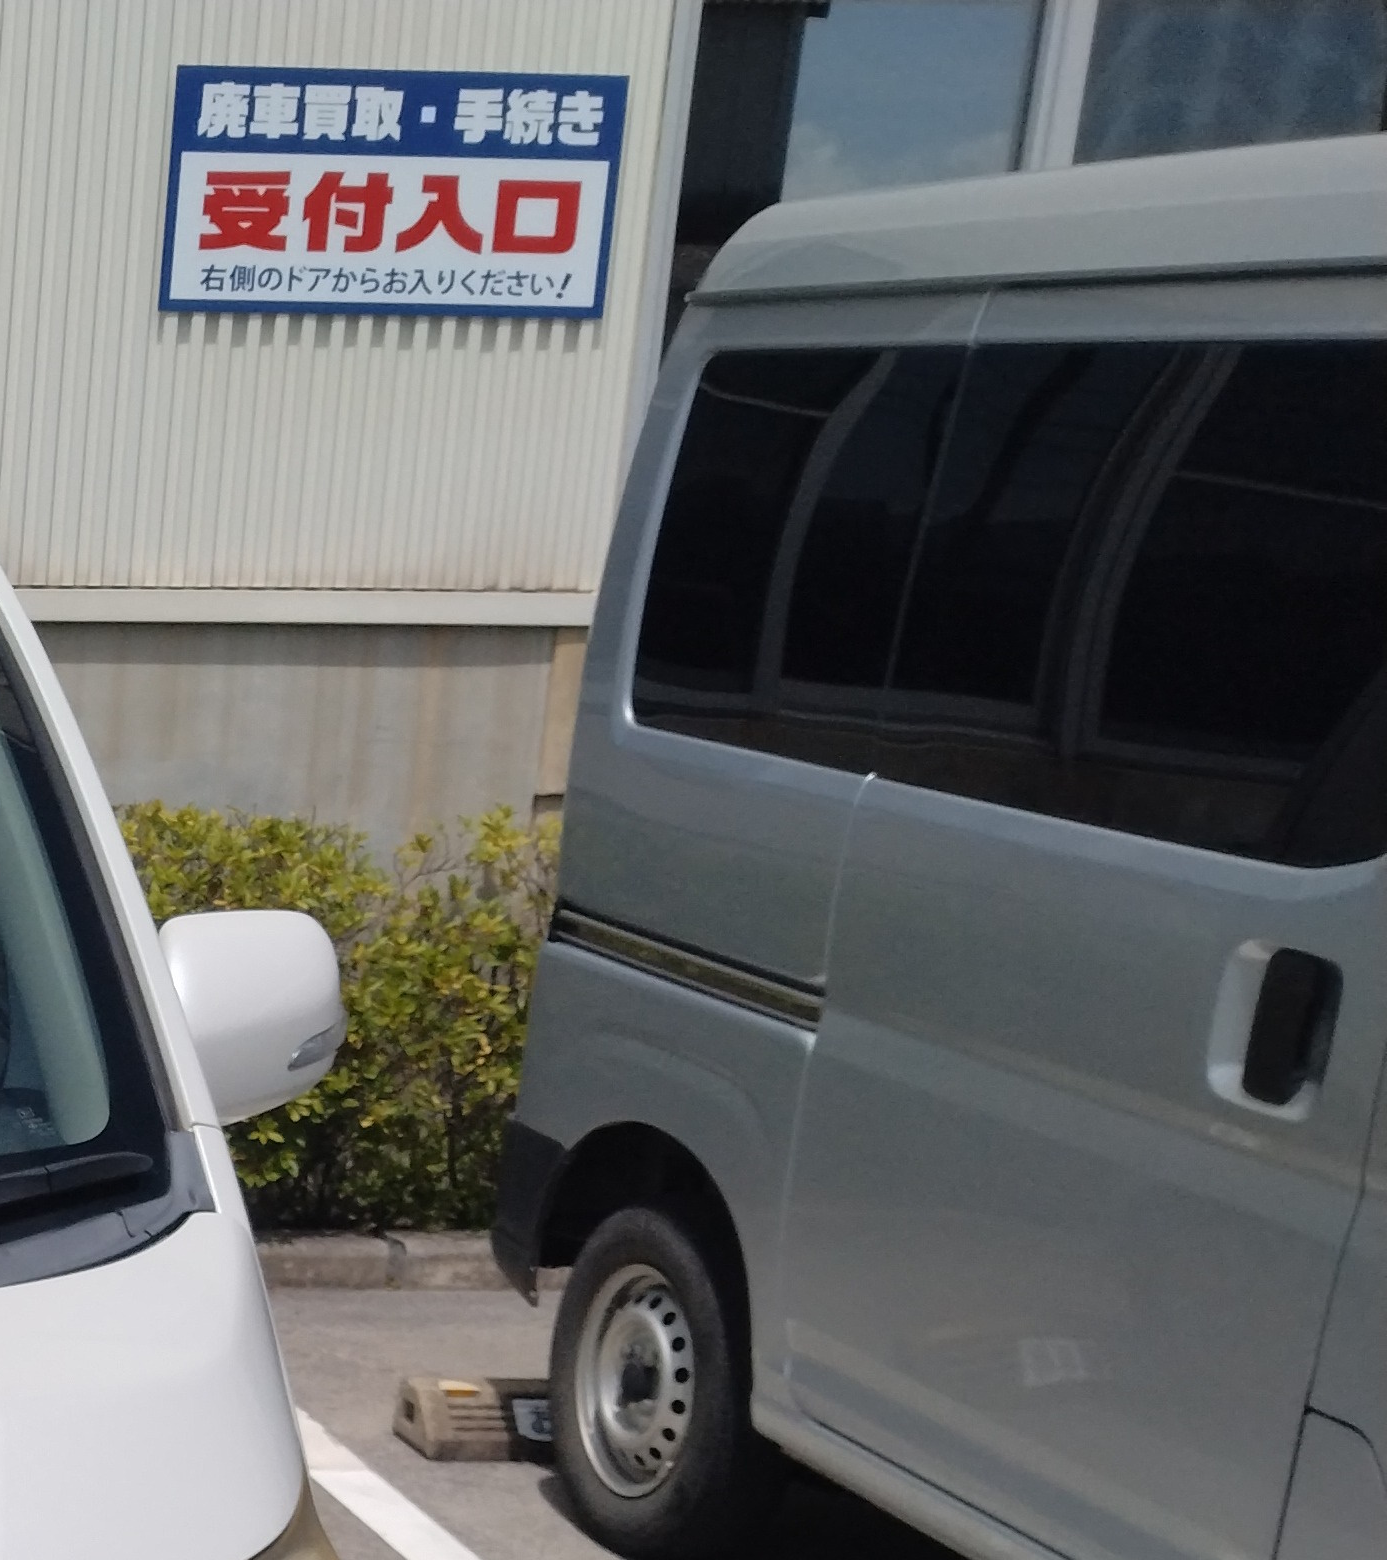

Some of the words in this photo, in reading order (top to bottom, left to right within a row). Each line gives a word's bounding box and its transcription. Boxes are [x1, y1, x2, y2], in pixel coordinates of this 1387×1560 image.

[196, 81, 605, 146] 廃車買取・手続き
[198, 170, 582, 255] 受付入口
[200, 264, 573, 299] 右側のドアからお入りください!
